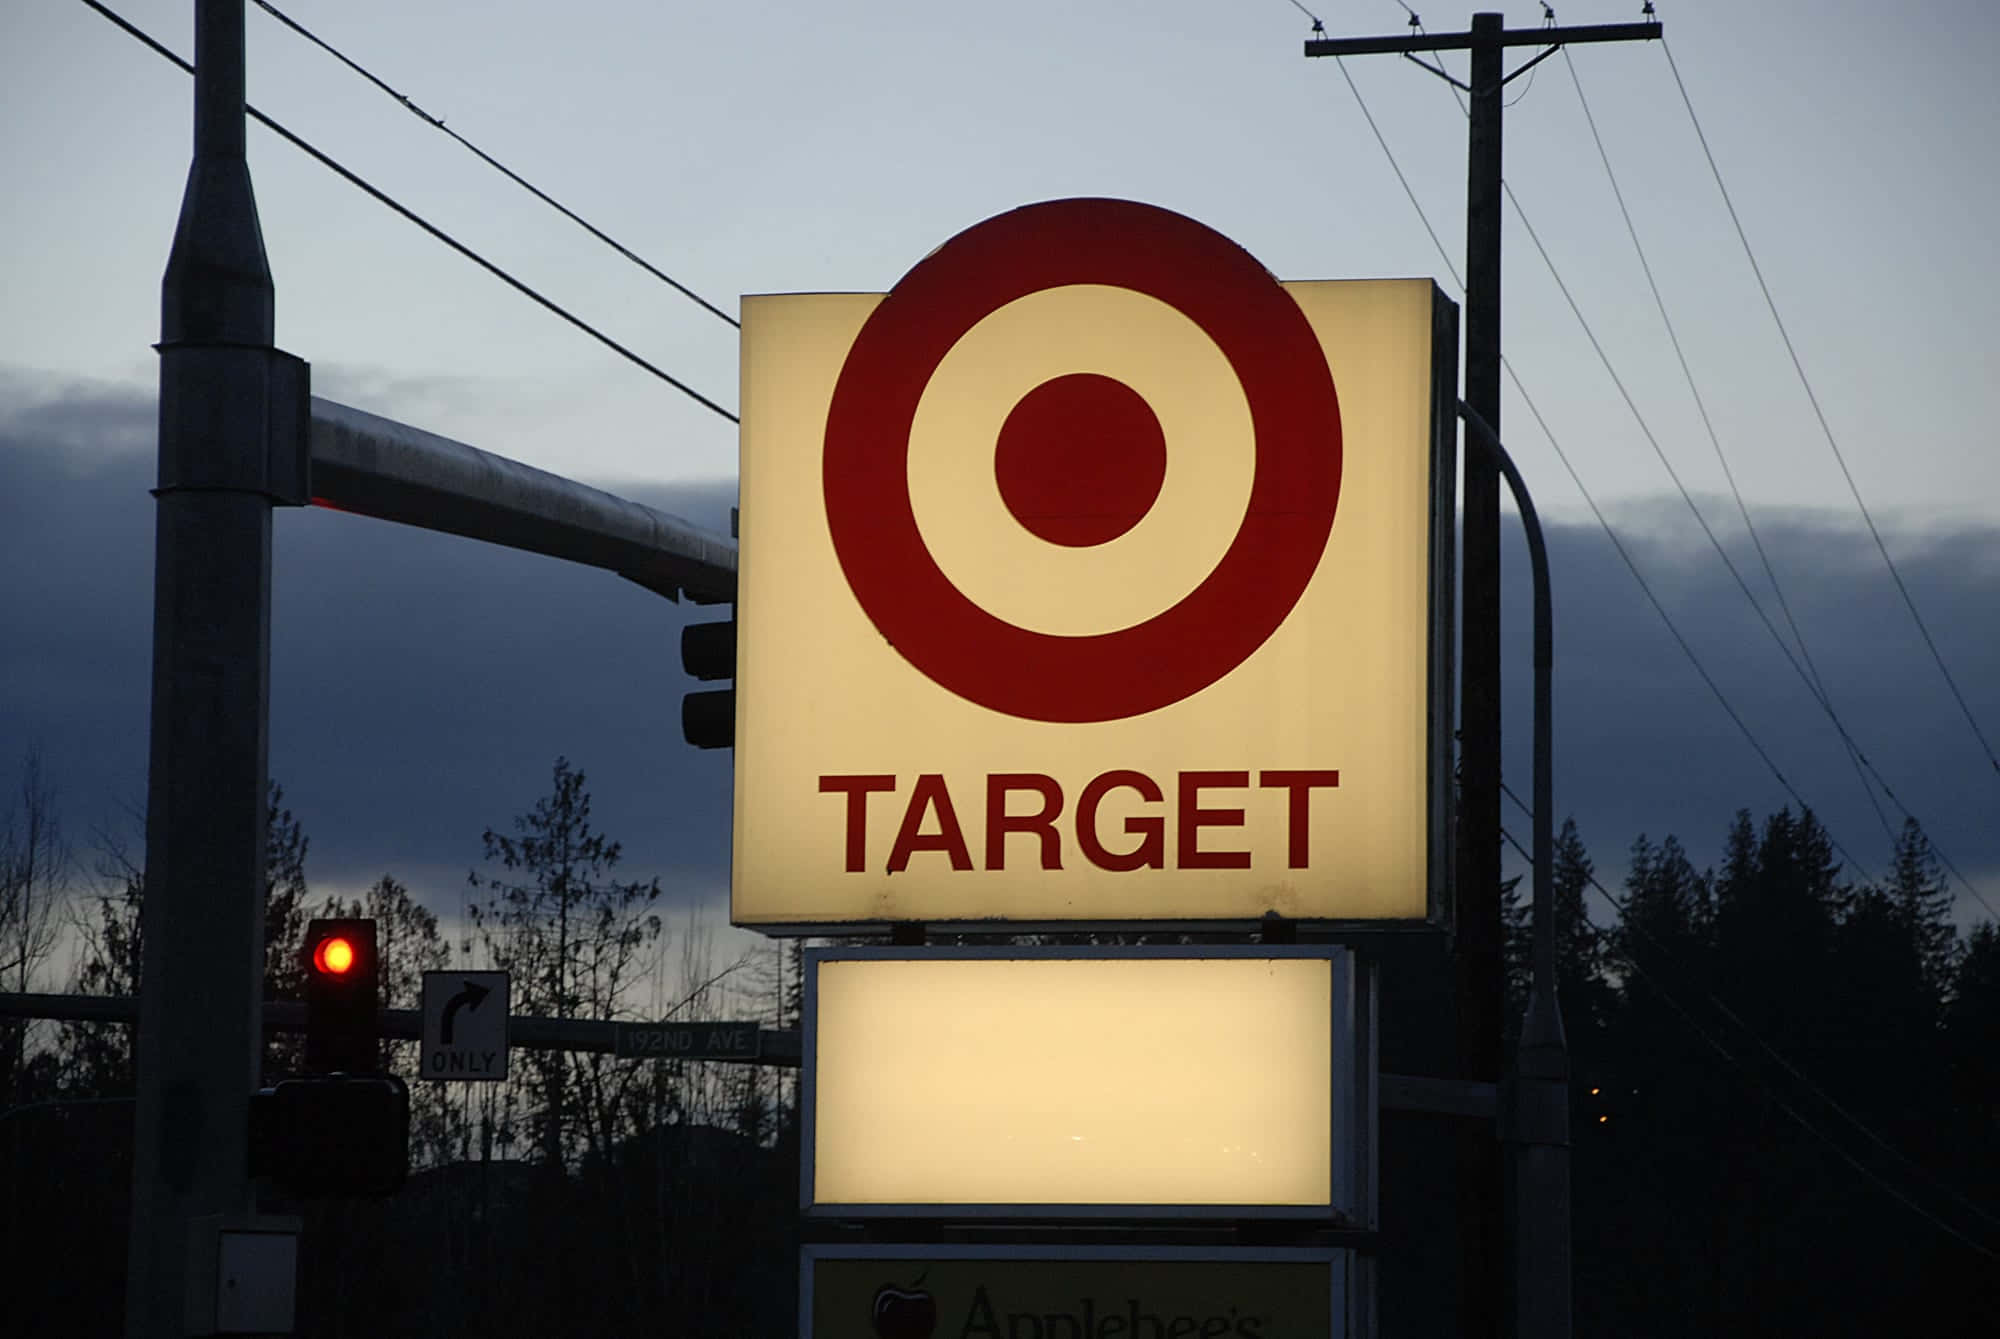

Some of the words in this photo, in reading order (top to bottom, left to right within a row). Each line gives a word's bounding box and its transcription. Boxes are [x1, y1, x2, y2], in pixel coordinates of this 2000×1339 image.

[818, 769, 1339, 873] TARGET
[629, 1030, 693, 1050] 192ND
[706, 1029, 746, 1050] AVE
[432, 1051, 496, 1073] ONLY
